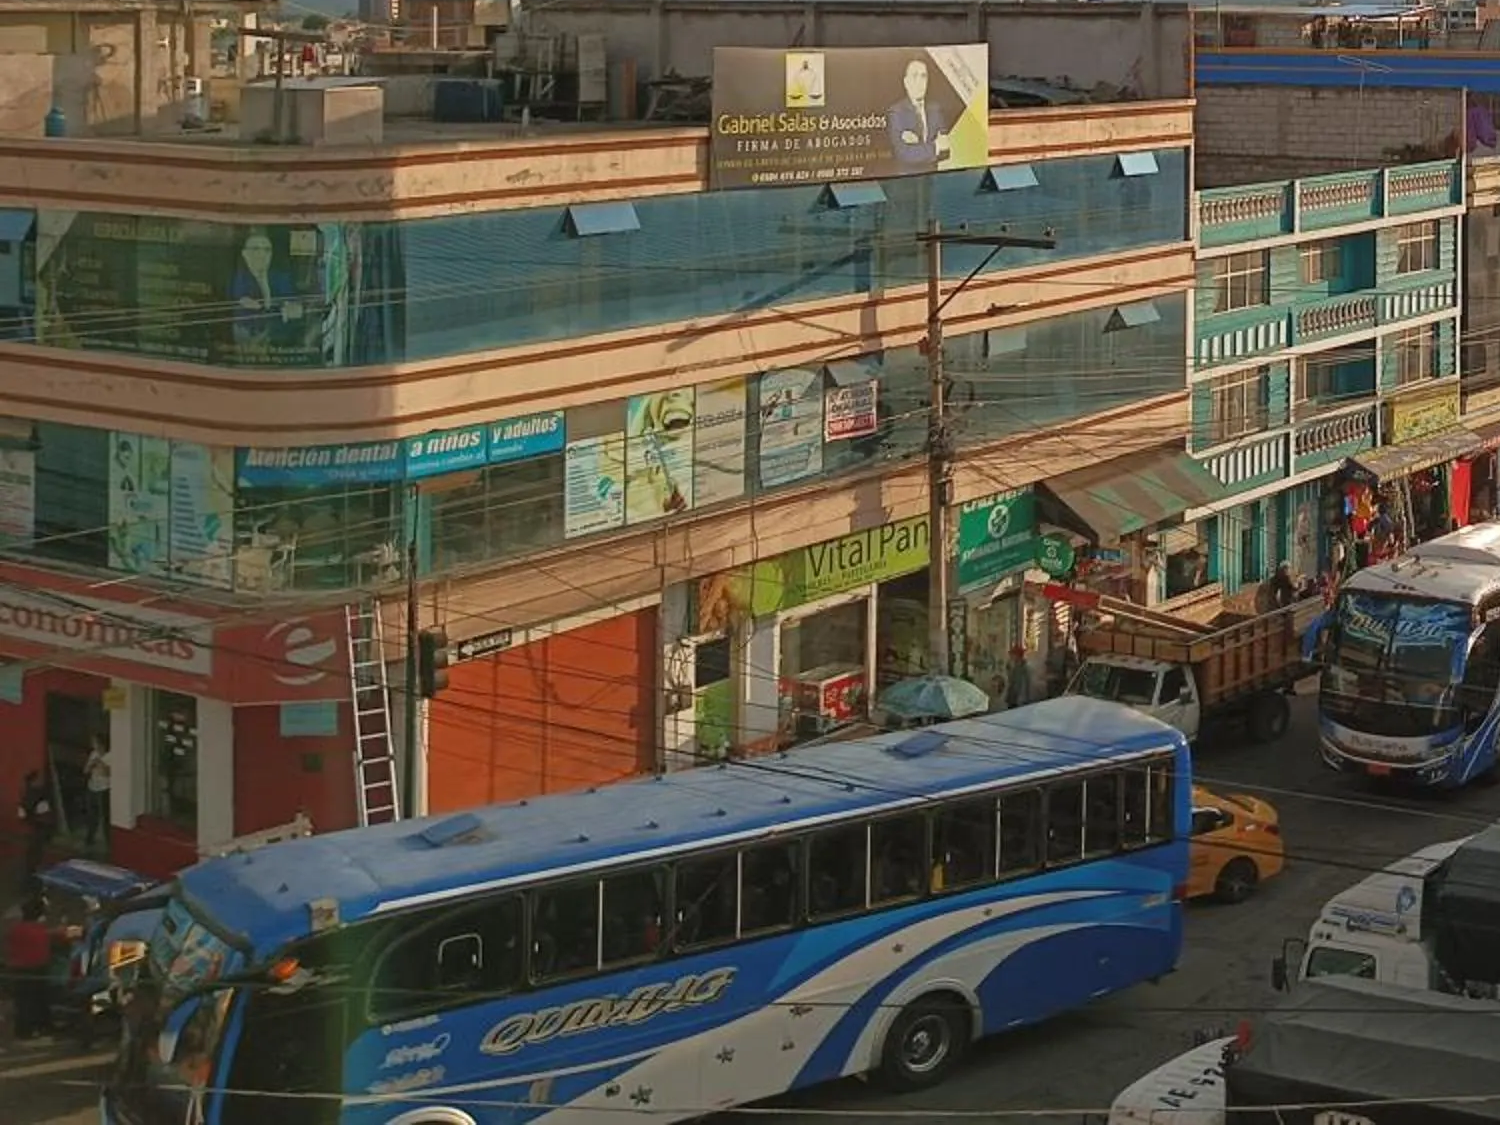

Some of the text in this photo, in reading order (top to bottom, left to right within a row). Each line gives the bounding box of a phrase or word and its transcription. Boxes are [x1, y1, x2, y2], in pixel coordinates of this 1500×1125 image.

[718, 113, 887, 134] Gabriel Salas & Asociados
[737, 135, 872, 152] FIRMA DE ABOGADOS
[335, 441, 398, 464] dental
[410, 441, 423, 457] a
[492, 426, 502, 444] y
[503, 416, 558, 440] adultos
[807, 527, 871, 578] Vital
[880, 521, 929, 558] Pan
